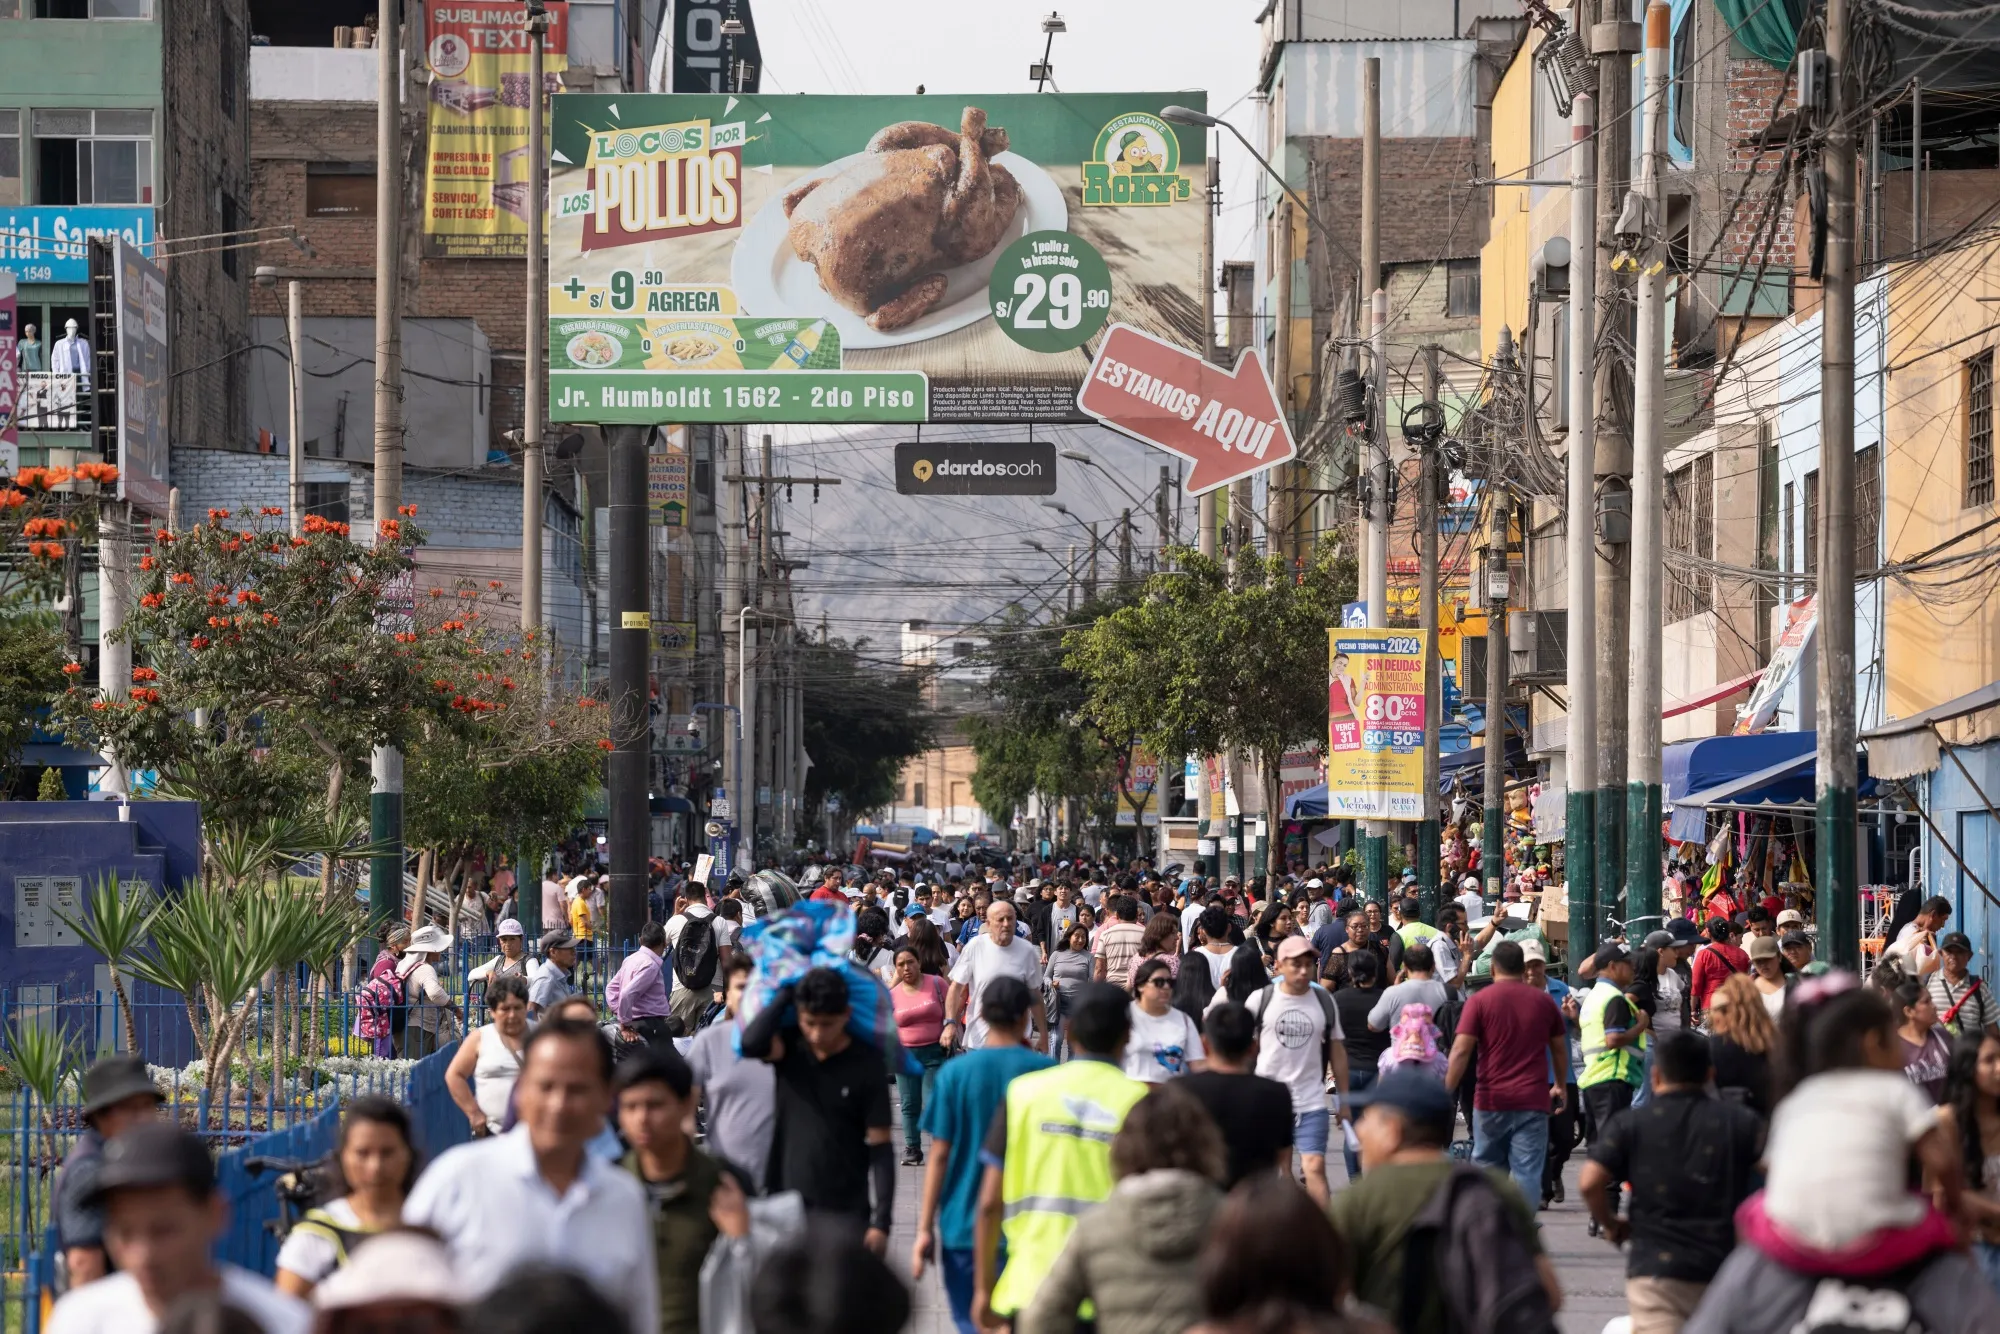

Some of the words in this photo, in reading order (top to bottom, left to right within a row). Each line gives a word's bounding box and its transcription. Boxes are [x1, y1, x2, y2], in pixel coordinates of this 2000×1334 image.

[468, 28, 554, 48] TEXTL
[432, 125, 487, 135] CALANDRADO
[500, 126, 525, 136] ROLLO
[1106, 115, 1168, 136] RESTAURANTE
[596, 127, 703, 159] LOCOS
[714, 127, 741, 145] POR
[482, 153, 492, 162] DE
[433, 165, 452, 175] ALTA
[453, 166, 490, 176] CALIDAD
[432, 192, 478, 204] SERVICIO
[595, 151, 739, 234] POLLOS
[562, 193, 591, 214] LOS
[432, 208, 463, 219] CORTE
[465, 208, 495, 219] LASER
[1032, 242, 1037, 253] 1
[1038, 240, 1061, 255] pollo
[1062, 243, 1069, 253] a
[1021, 257, 1031, 269] la
[1031, 254, 1056, 268] brasa
[1057, 255, 1079, 269] solo
[23, 266, 52, 280] 1549
[610, 270, 634, 311] 9
[647, 291, 720, 312] AGREGA
[1014, 272, 1082, 329] 29
[560, 321, 596, 335] ENSALADA
[598, 321, 631, 339] FAMILIAR
[653, 324, 675, 338] PAPAS
[676, 321, 700, 332] FRITAS
[701, 322, 732, 339] FAMILIAR
[754, 322, 787, 338] GASEOSA
[557, 386, 590, 408] Jr.
[602, 386, 711, 408] Humboldt
[722, 386, 781, 408] 1562
[810, 386, 852, 408] 2do
[863, 386, 915, 408] Piso
[1096, 356, 1201, 421] ESTAMOS
[1192, 399, 1281, 460] AQUÍ
[936, 459, 1042, 476] dardosooh
[1387, 638, 1417, 653] 2024
[1367, 659, 1382, 671] SIN
[1384, 660, 1421, 672] DEUDAS
[1376, 672, 1385, 681] EN
[1387, 672, 1412, 682] MULTAS
[1365, 682, 1423, 692] ADMINISTRATIVAS
[1335, 722, 1355, 731] VENCE
[1340, 731, 1353, 743] 31
[1334, 742, 1360, 750] DICIEMBRE
